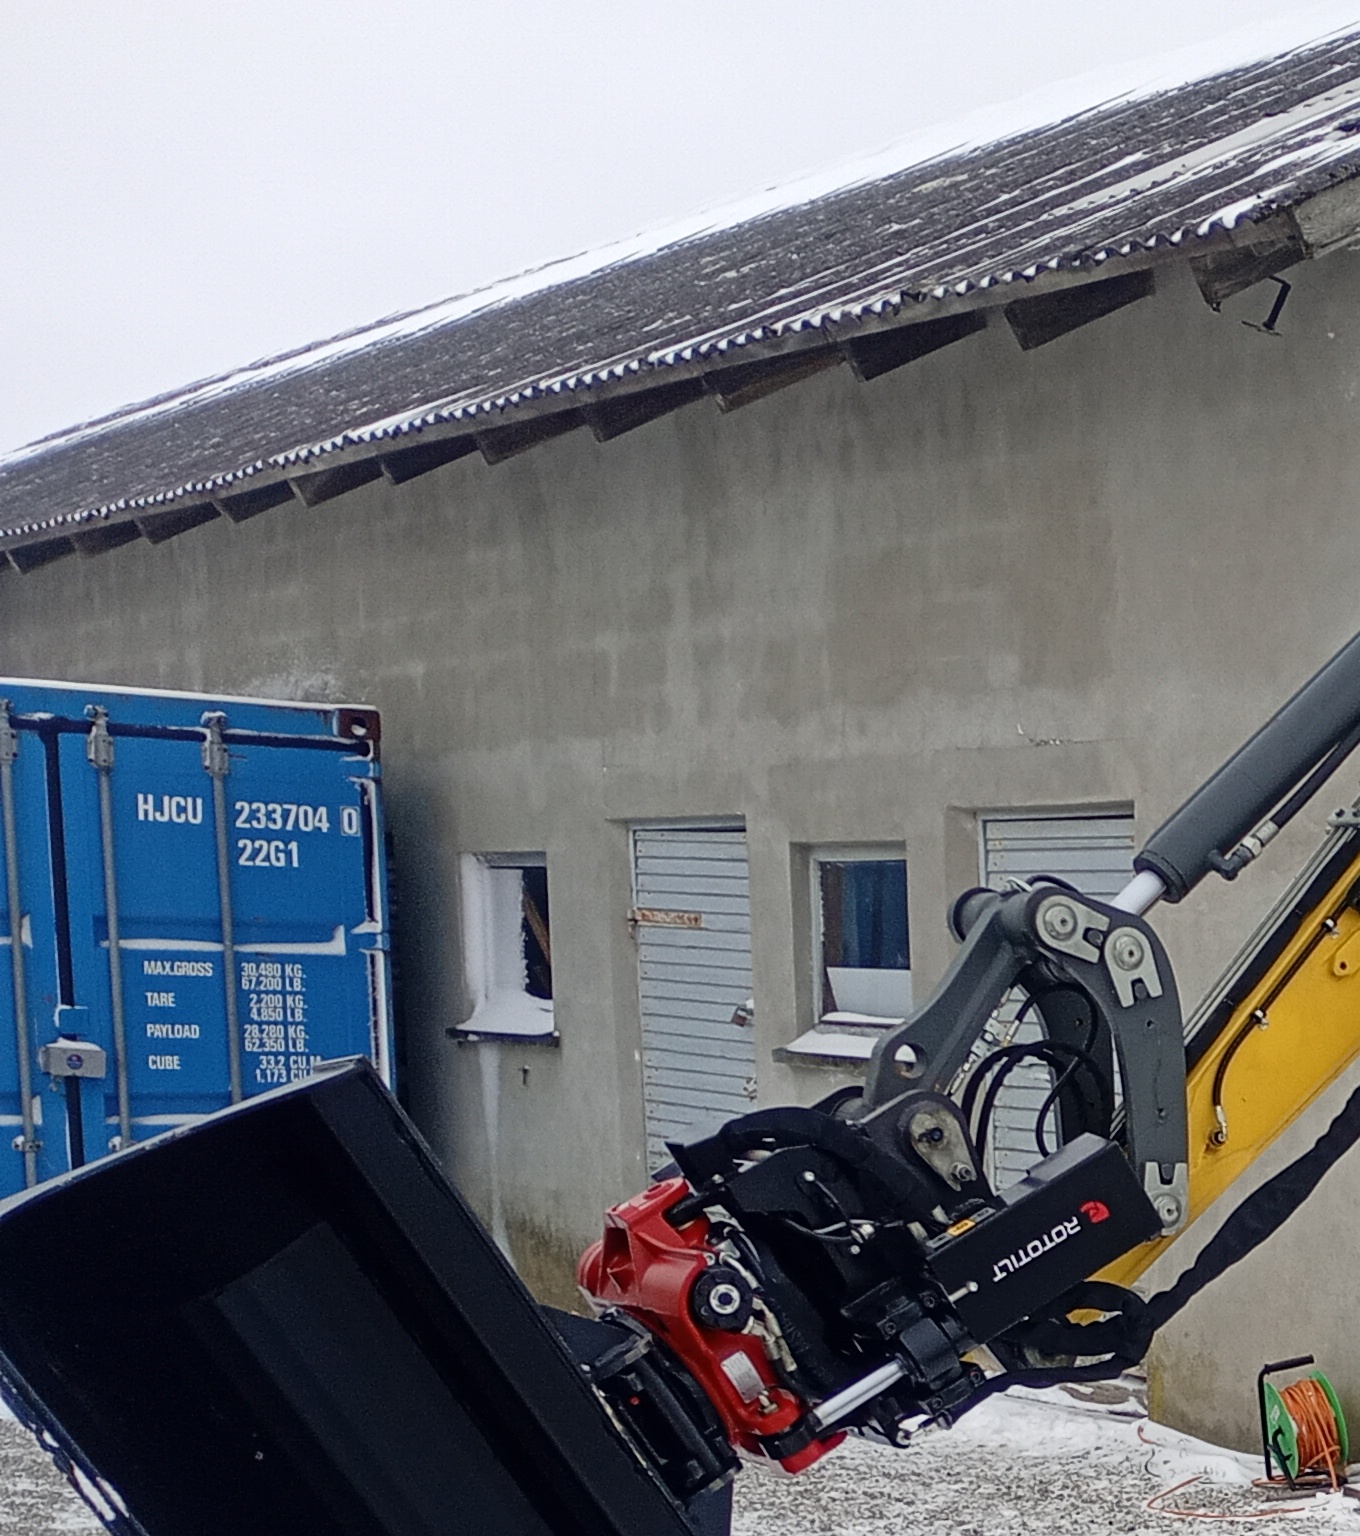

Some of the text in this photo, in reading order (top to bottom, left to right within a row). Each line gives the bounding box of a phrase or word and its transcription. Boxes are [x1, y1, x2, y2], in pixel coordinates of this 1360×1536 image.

[137, 793, 358, 835] HJCU 233704 0
[238, 839, 300, 868] 22G1
[240, 962, 281, 977] 30.480
[285, 963, 307, 978] KG.
[241, 976, 306, 992] 67.200 LB.
[145, 992, 308, 1009] TARE 2.200 KG.
[250, 1008, 308, 1023] 4.850 LB.
[146, 1023, 309, 1039] PAYLOAD 28.280 KG.
[244, 1039, 309, 1053] 62.350 LB.
[148, 1055, 182, 1070] CUBE
[992, 1216, 1082, 1283] ROTOTILT
